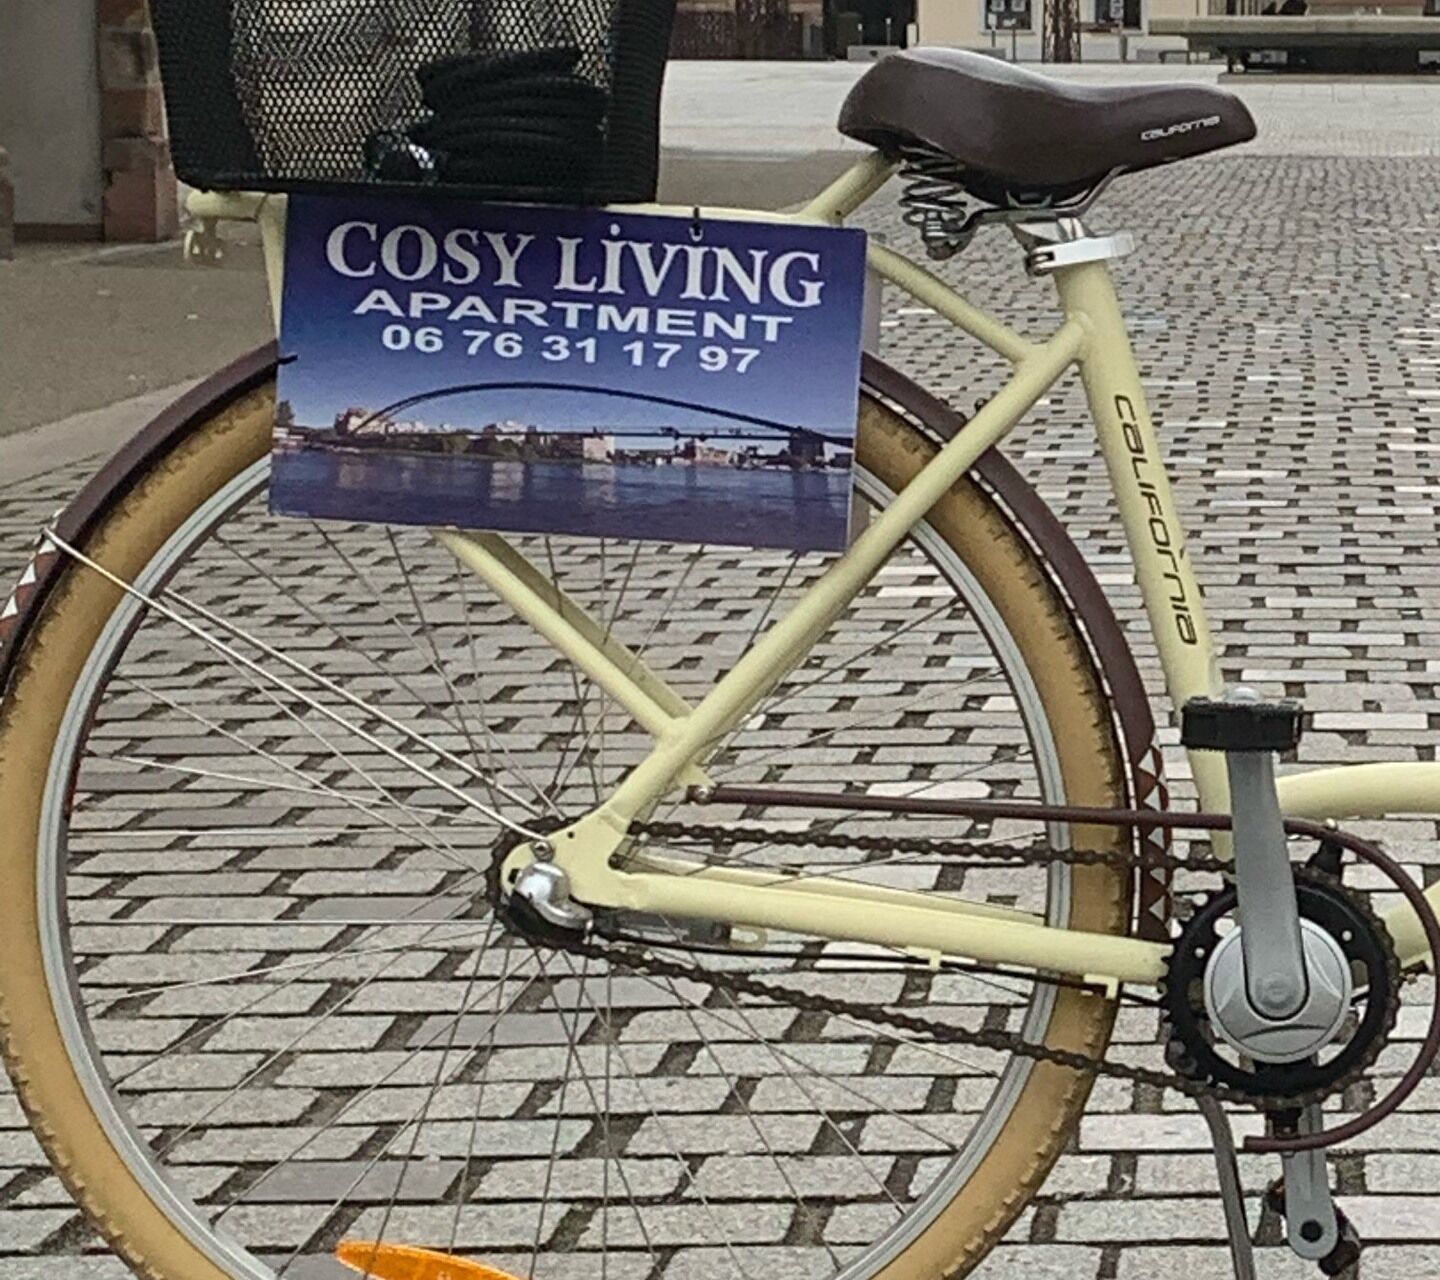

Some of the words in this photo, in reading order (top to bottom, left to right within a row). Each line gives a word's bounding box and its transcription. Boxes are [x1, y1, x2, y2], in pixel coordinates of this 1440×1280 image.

[326, 221, 535, 288] COSY
[353, 288, 793, 342] APARTMENT
[381, 324, 444, 353] 06
[461, 329, 523, 358] 76
[541, 335, 597, 363] 31
[623, 340, 682, 368] 17
[699, 345, 761, 374] 97
